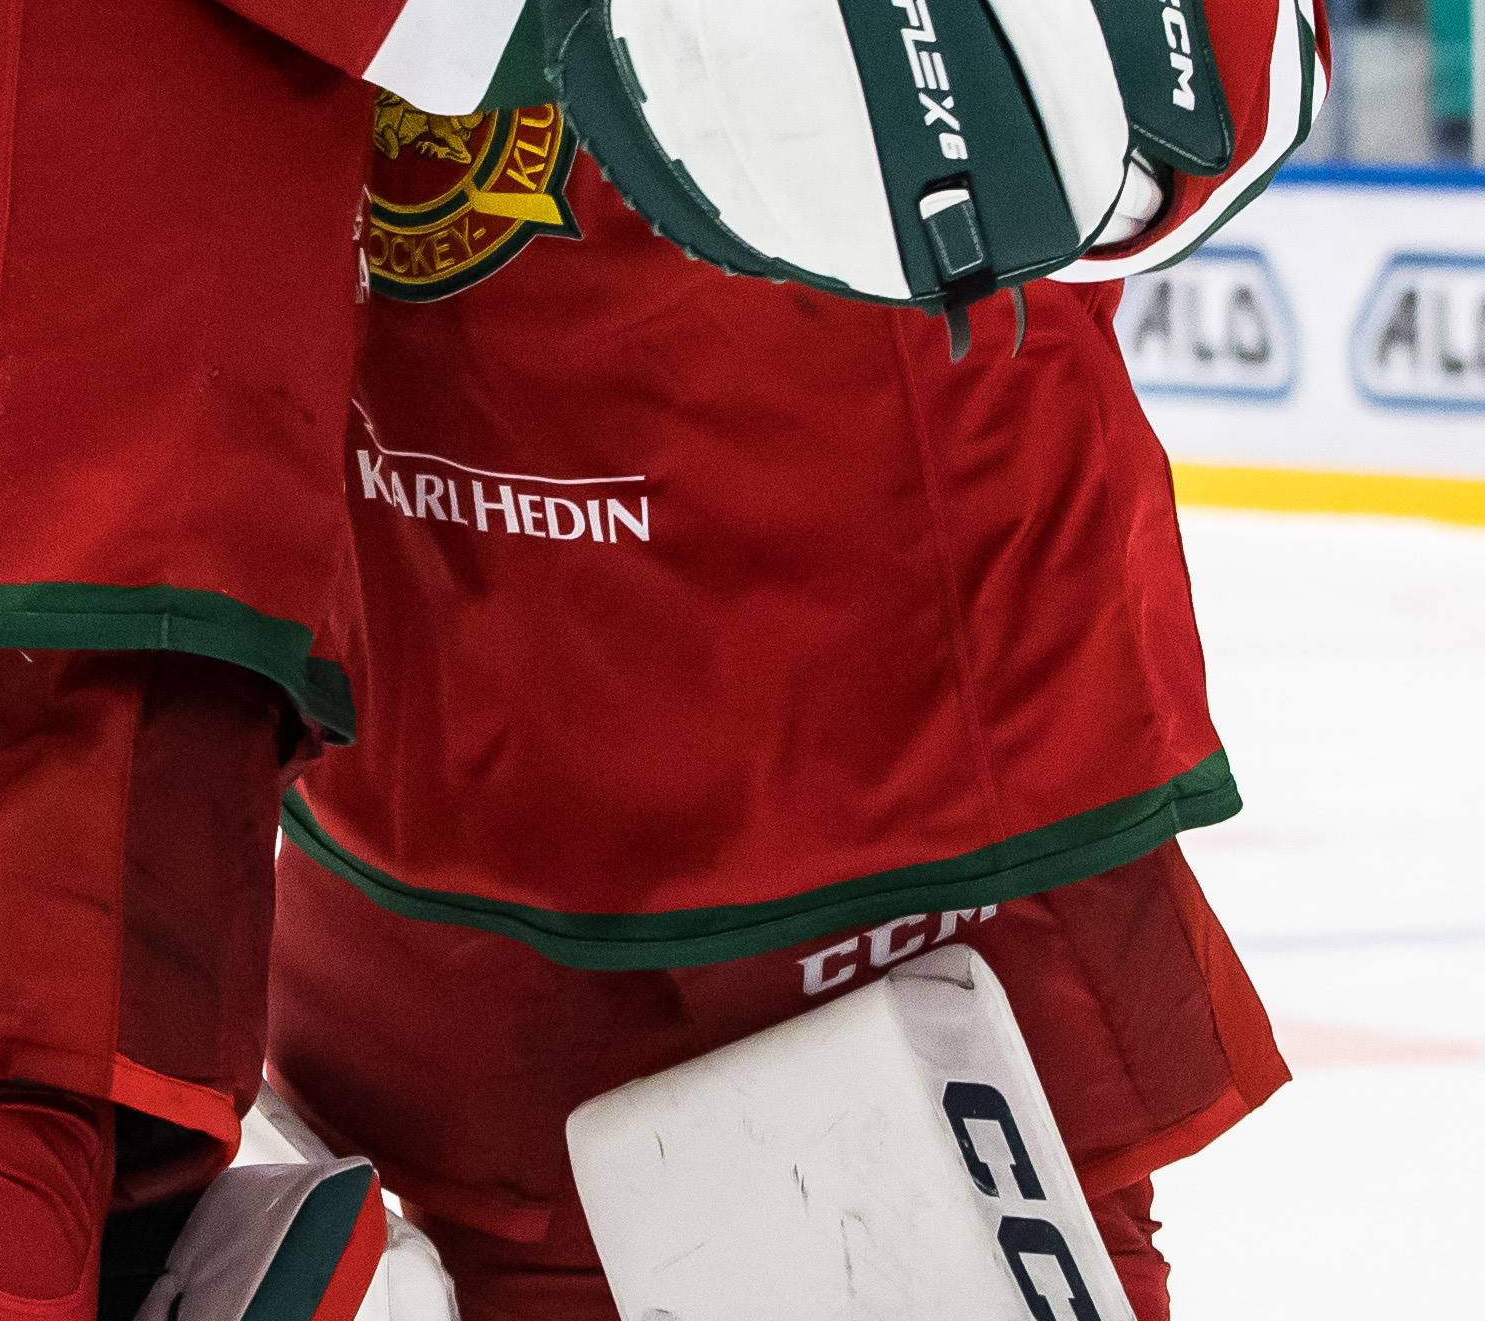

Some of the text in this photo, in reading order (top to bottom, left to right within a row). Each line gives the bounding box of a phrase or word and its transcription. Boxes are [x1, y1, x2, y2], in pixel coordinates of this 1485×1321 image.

[505, 103, 555, 192] KLU
[369, 217, 487, 275] OCKEY-
[356, 449, 651, 544] KARL HEDIN
[794, 902, 998, 996] CCM
